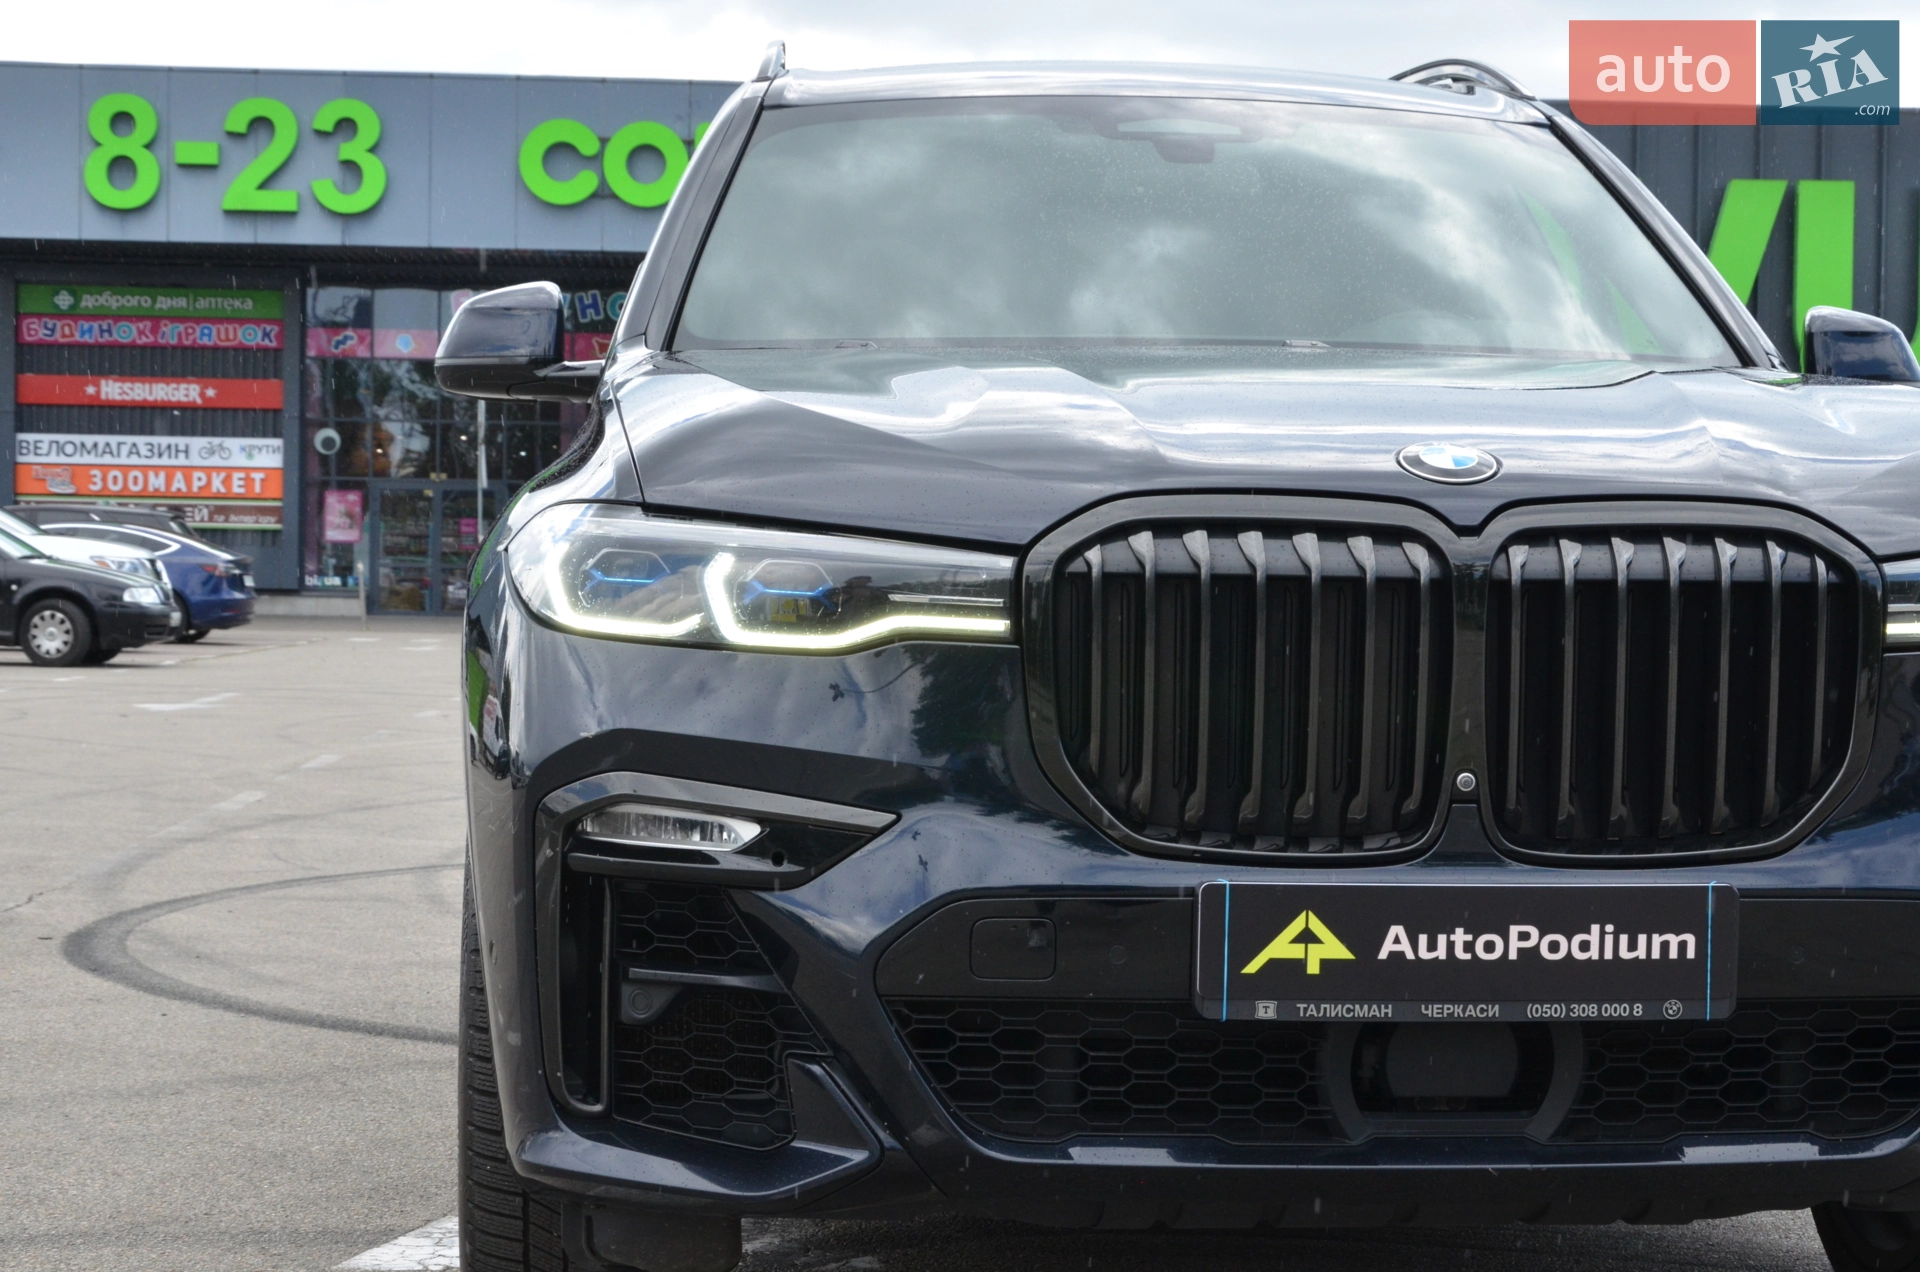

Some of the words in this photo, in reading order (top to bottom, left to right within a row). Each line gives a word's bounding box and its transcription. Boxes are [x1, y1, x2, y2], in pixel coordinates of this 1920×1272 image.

[83, 92, 388, 214] 8-23
[519, 118, 711, 208] co
[80, 290, 152, 310] доброго
[154, 294, 187, 310] дня
[194, 295, 254, 311] аптека
[22, 317, 154, 342] БУДИНОК
[100, 379, 203, 404] HESBURGER
[18, 439, 190, 460] ВЕЛОМАГАЗИН
[88, 469, 266, 495] ЗООМАРКЕТ
[1377, 923, 1697, 961] AutoPodium
[1296, 1003, 1393, 1018] ТАЛИСМАН
[1420, 1003, 1500, 1018] ЧЕРКАСИ
[1526, 1003, 1566, 1019] (050)
[1569, 1004, 1598, 1018] 308
[1601, 1004, 1630, 1018] 000
[1633, 1003, 1643, 1017] 8
